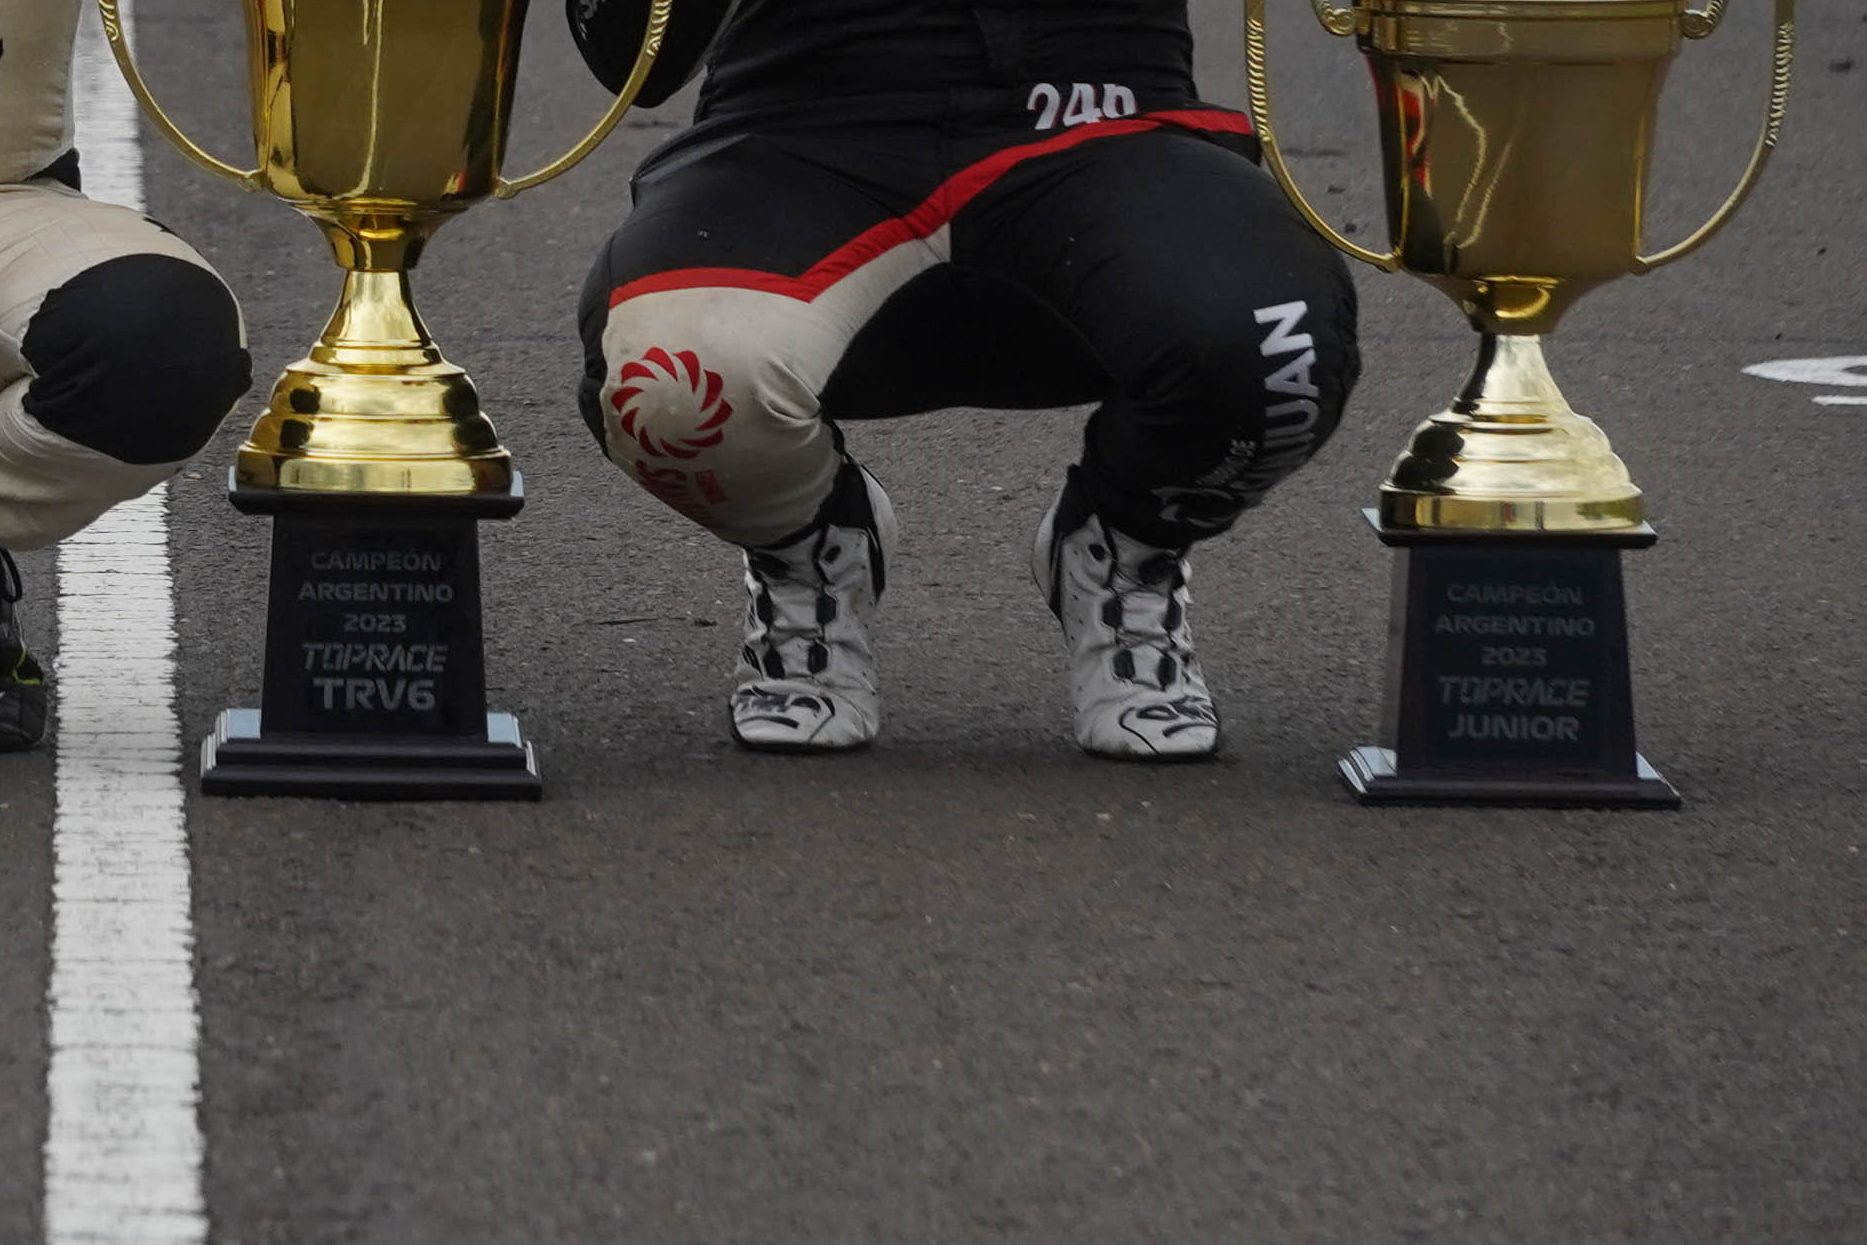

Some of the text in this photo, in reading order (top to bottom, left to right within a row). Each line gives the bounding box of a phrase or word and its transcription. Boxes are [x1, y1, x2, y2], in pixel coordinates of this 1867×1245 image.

[311, 551, 441, 572] CAMPEÓN
[298, 581, 454, 602] ARGENTINO
[1446, 582, 1582, 604] CAMPEÓN
[343, 614, 407, 633] 2023
[1435, 613, 1596, 636] ARGENTINO
[303, 643, 449, 672] TOPRACE
[1481, 647, 1548, 667] 2023
[313, 678, 436, 711] TRV6
[1447, 712, 1581, 741] JUNIOR
